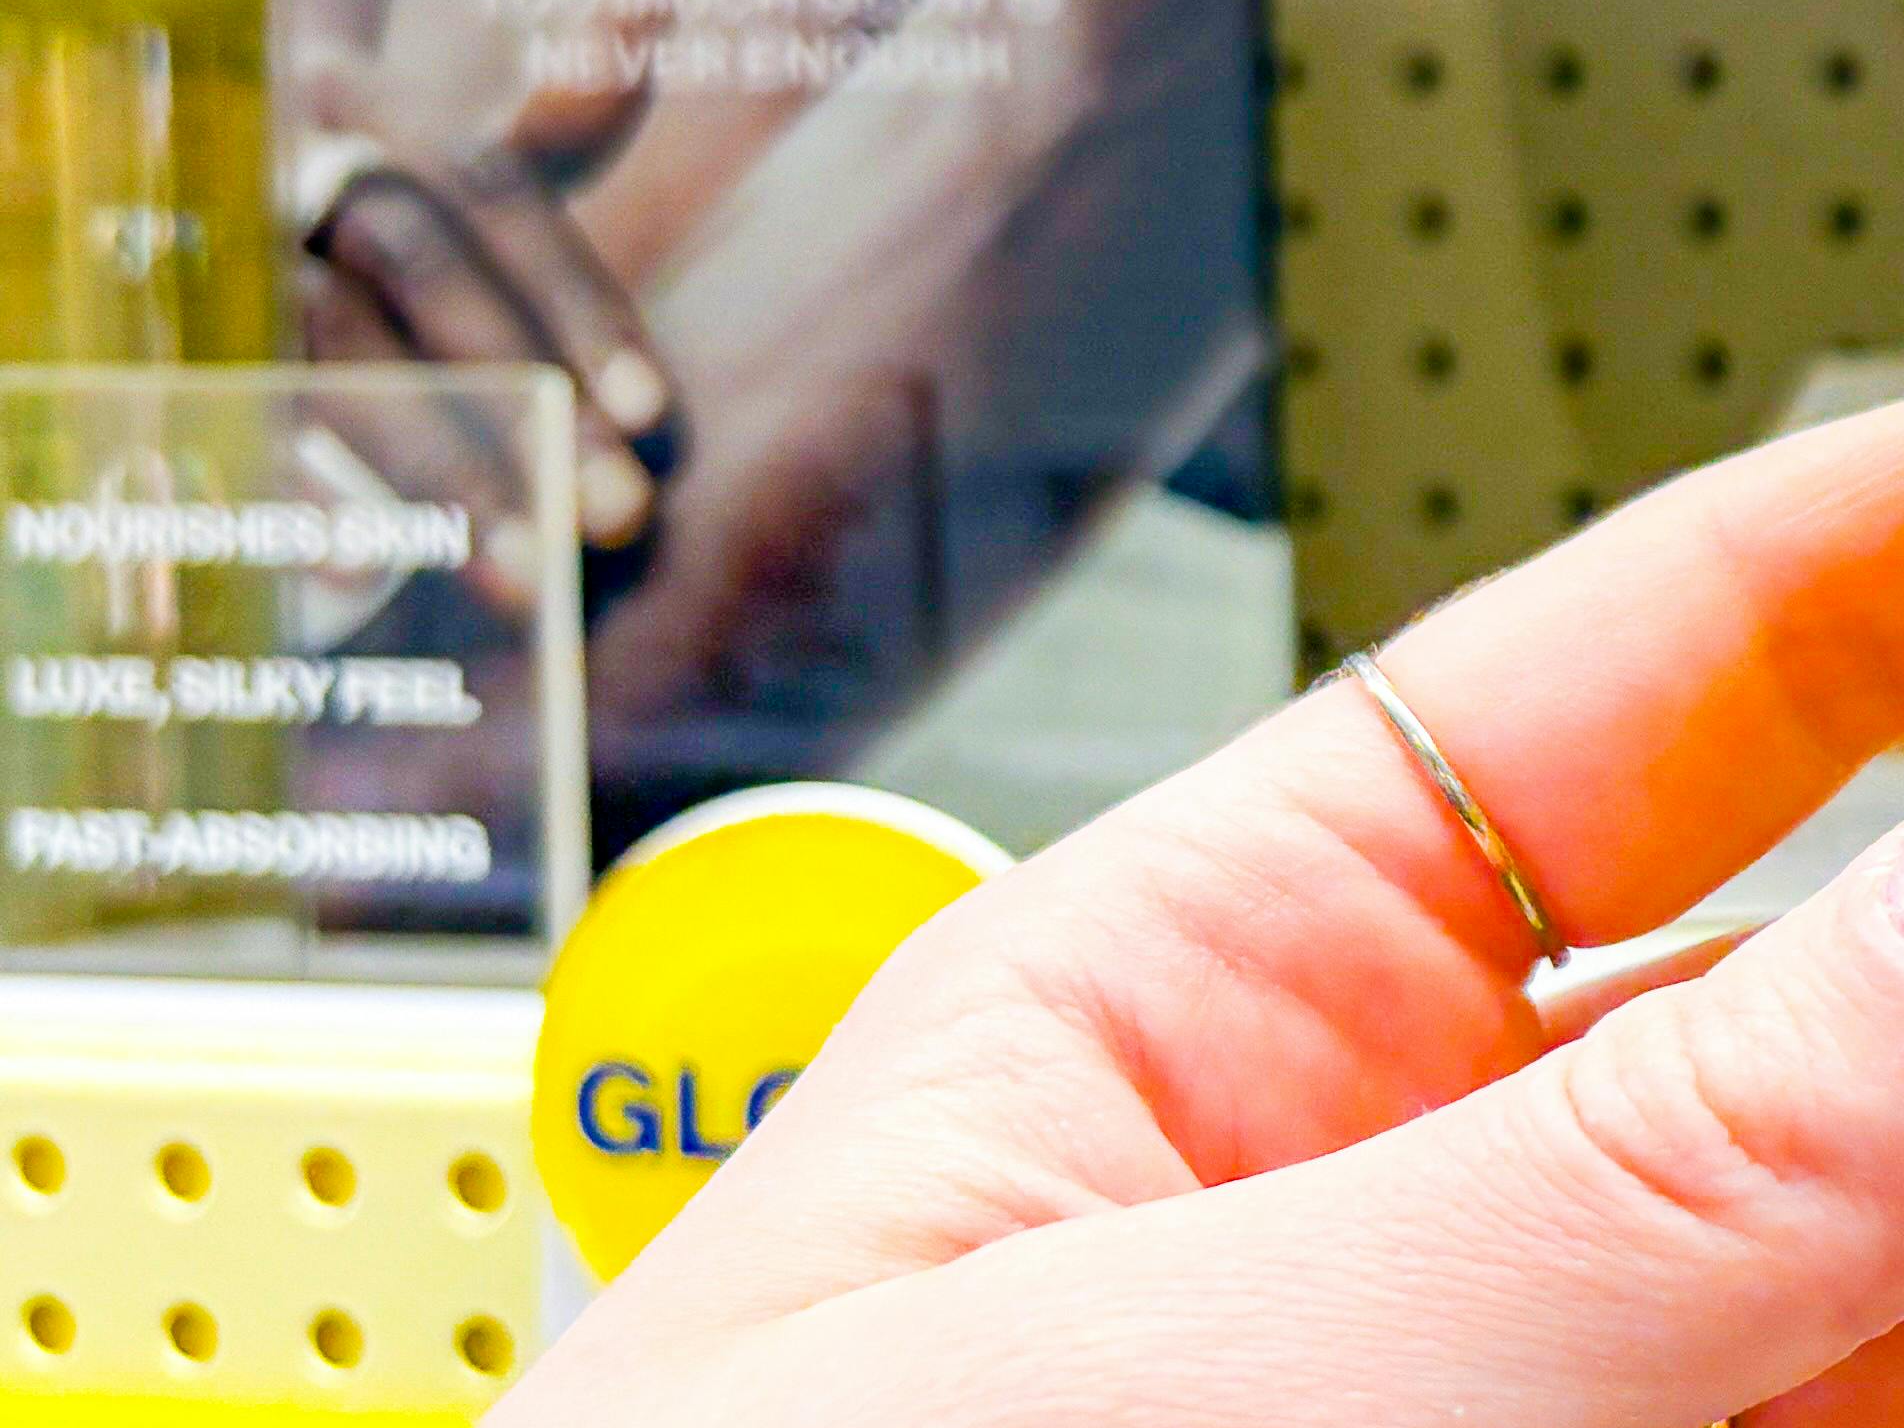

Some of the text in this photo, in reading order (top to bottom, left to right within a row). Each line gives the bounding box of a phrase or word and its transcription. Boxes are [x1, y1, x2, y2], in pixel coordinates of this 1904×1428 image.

[9, 503, 471, 570] NOURISHES SKIN
[12, 656, 483, 728] LUXE, SILKY FEEL
[9, 808, 491, 881] FAST-ABSORBING
